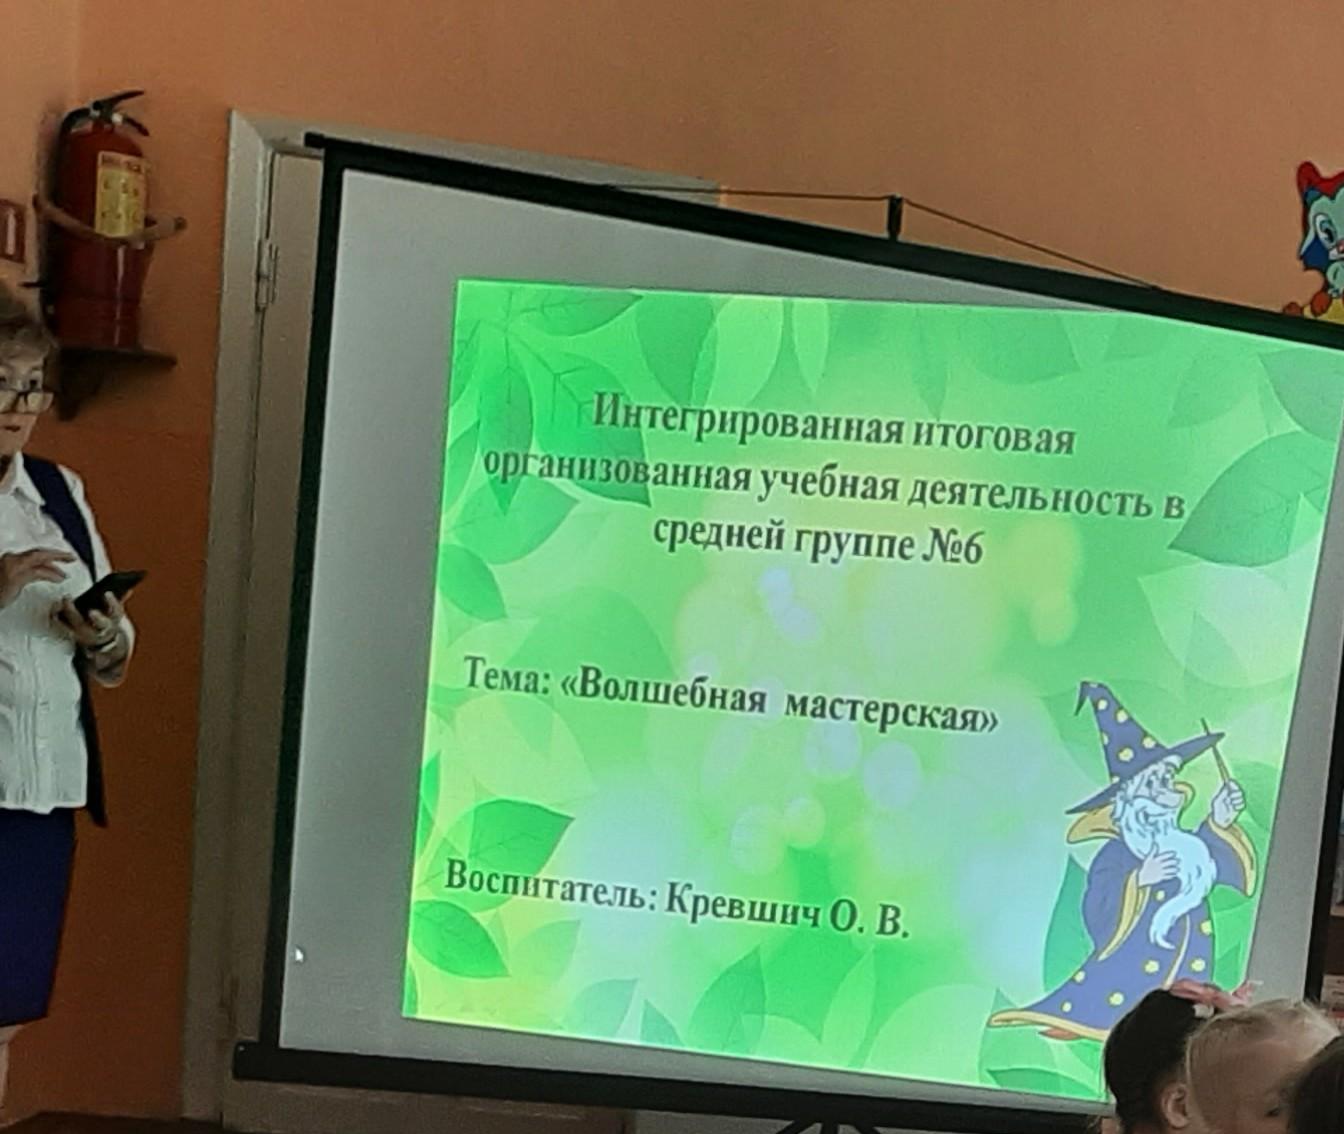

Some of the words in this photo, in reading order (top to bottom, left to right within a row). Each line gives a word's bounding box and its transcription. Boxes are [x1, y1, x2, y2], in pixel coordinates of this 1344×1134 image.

[594, 391, 905, 446] Интегрированная
[913, 421, 1076, 455] итоговая
[483, 451, 752, 492] организованная
[757, 462, 900, 503] учебная
[907, 479, 1153, 517] деятельность
[1164, 496, 1185, 519] в
[653, 518, 786, 553] средней
[794, 529, 915, 565] группе
[921, 527, 985, 565] №6
[463, 655, 550, 695] Тема:
[561, 665, 767, 714] «Волшебная
[785, 693, 999, 734] мастерская»
[444, 857, 657, 911] Воспитатель:
[665, 881, 821, 928] Кревшич
[829, 898, 864, 934] О.
[875, 903, 909, 938] В.
